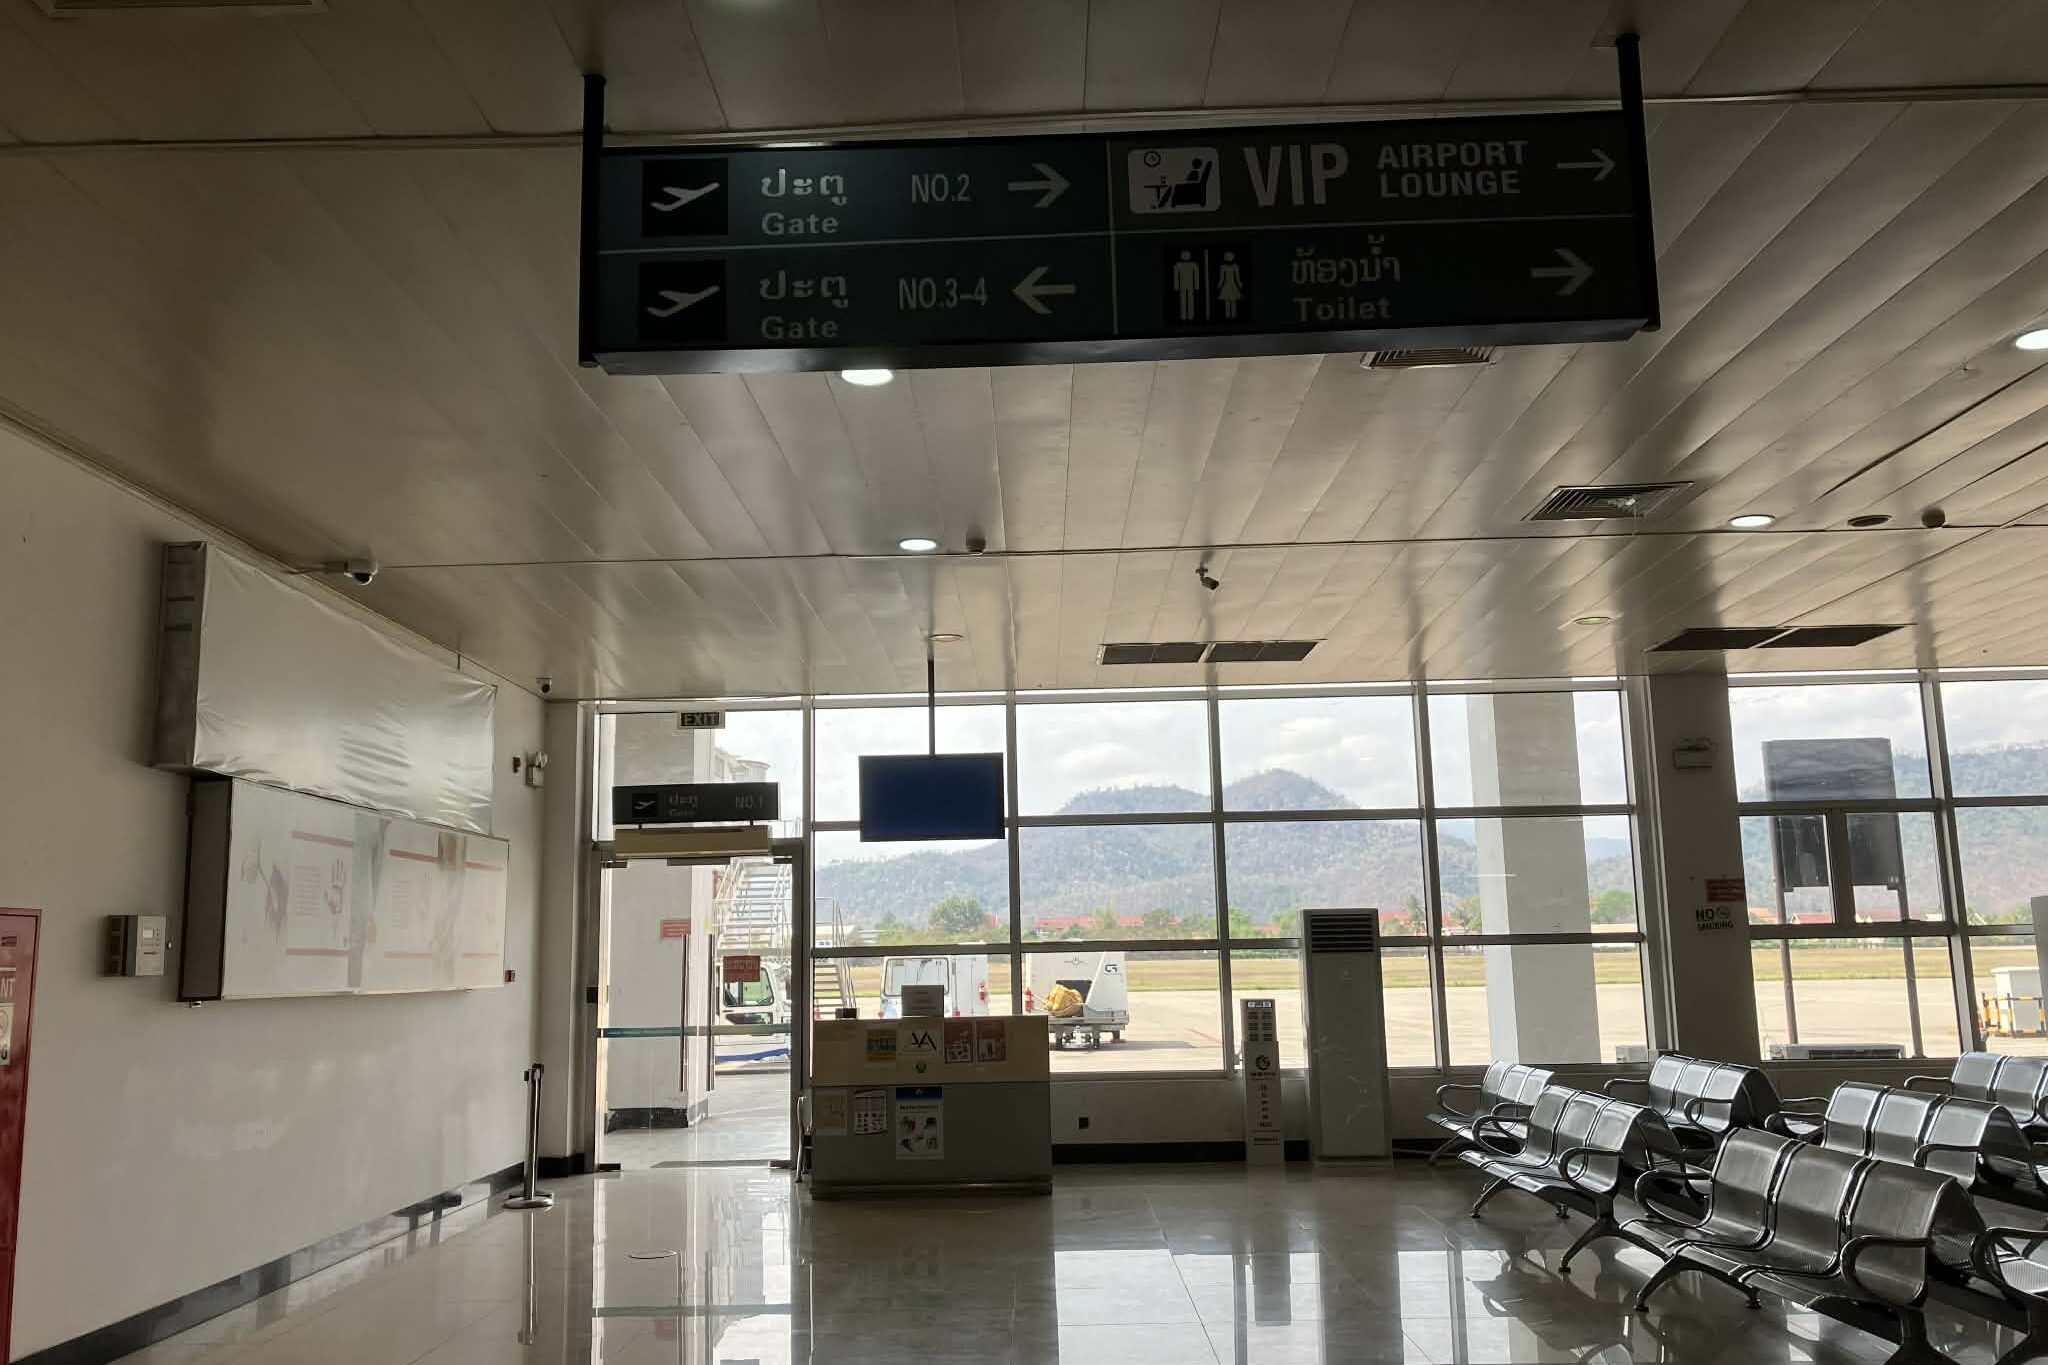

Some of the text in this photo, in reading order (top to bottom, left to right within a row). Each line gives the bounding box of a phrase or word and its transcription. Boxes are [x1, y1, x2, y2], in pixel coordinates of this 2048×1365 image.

[1376, 139, 1528, 170] AIRPORT
[760, 168, 847, 206] ປະຕູ
[911, 172, 972, 203] NO.2
[1242, 141, 1350, 208] VIP
[1379, 168, 1521, 199] LOUNGE
[761, 211, 839, 235] Gate
[759, 270, 849, 309] ປະຕູ
[897, 275, 989, 310] NO.3-4
[1292, 296, 1393, 322] Toilet
[760, 315, 840, 340] Gate
[684, 713, 718, 726] EXIT
